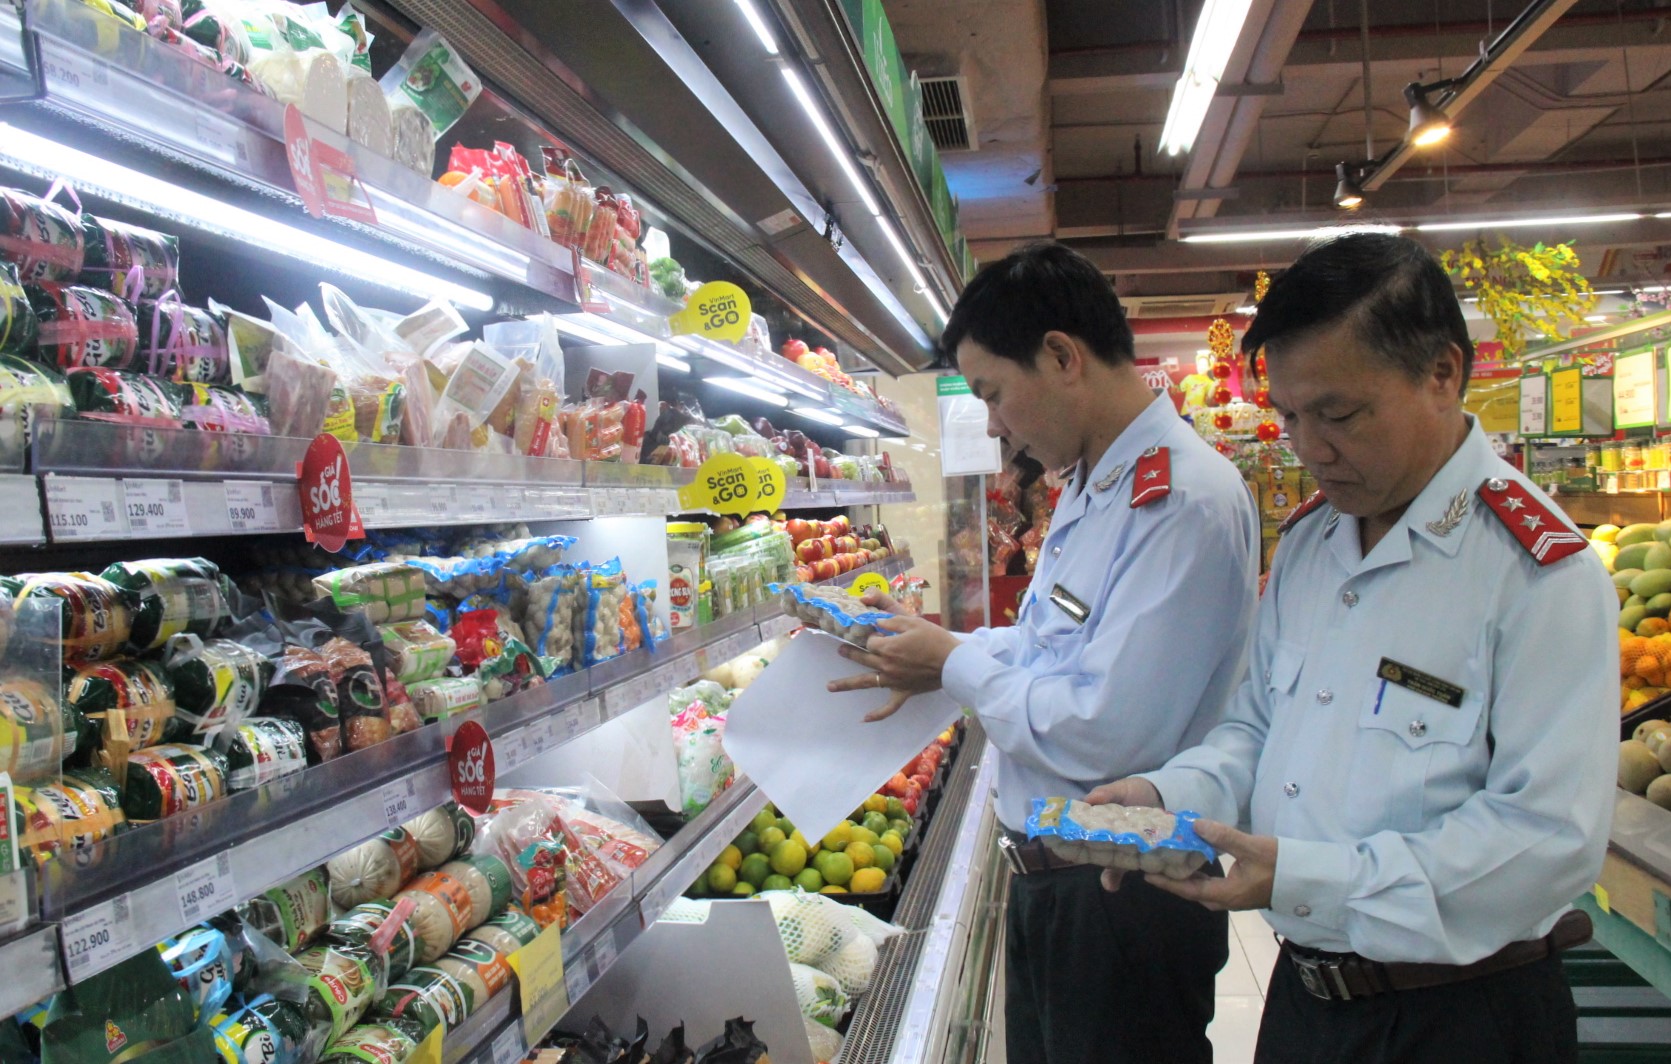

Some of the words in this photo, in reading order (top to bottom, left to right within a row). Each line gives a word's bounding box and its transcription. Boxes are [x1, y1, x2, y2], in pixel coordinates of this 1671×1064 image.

[699, 300, 737, 316] Scan
[707, 472, 745, 490] Scan
[128, 503, 164, 517] 129.400
[229, 507, 256, 520] 89.900
[50, 513, 88, 527] 115.100
[181, 882, 215, 908] 148.800
[68, 929, 110, 958] 122.900
